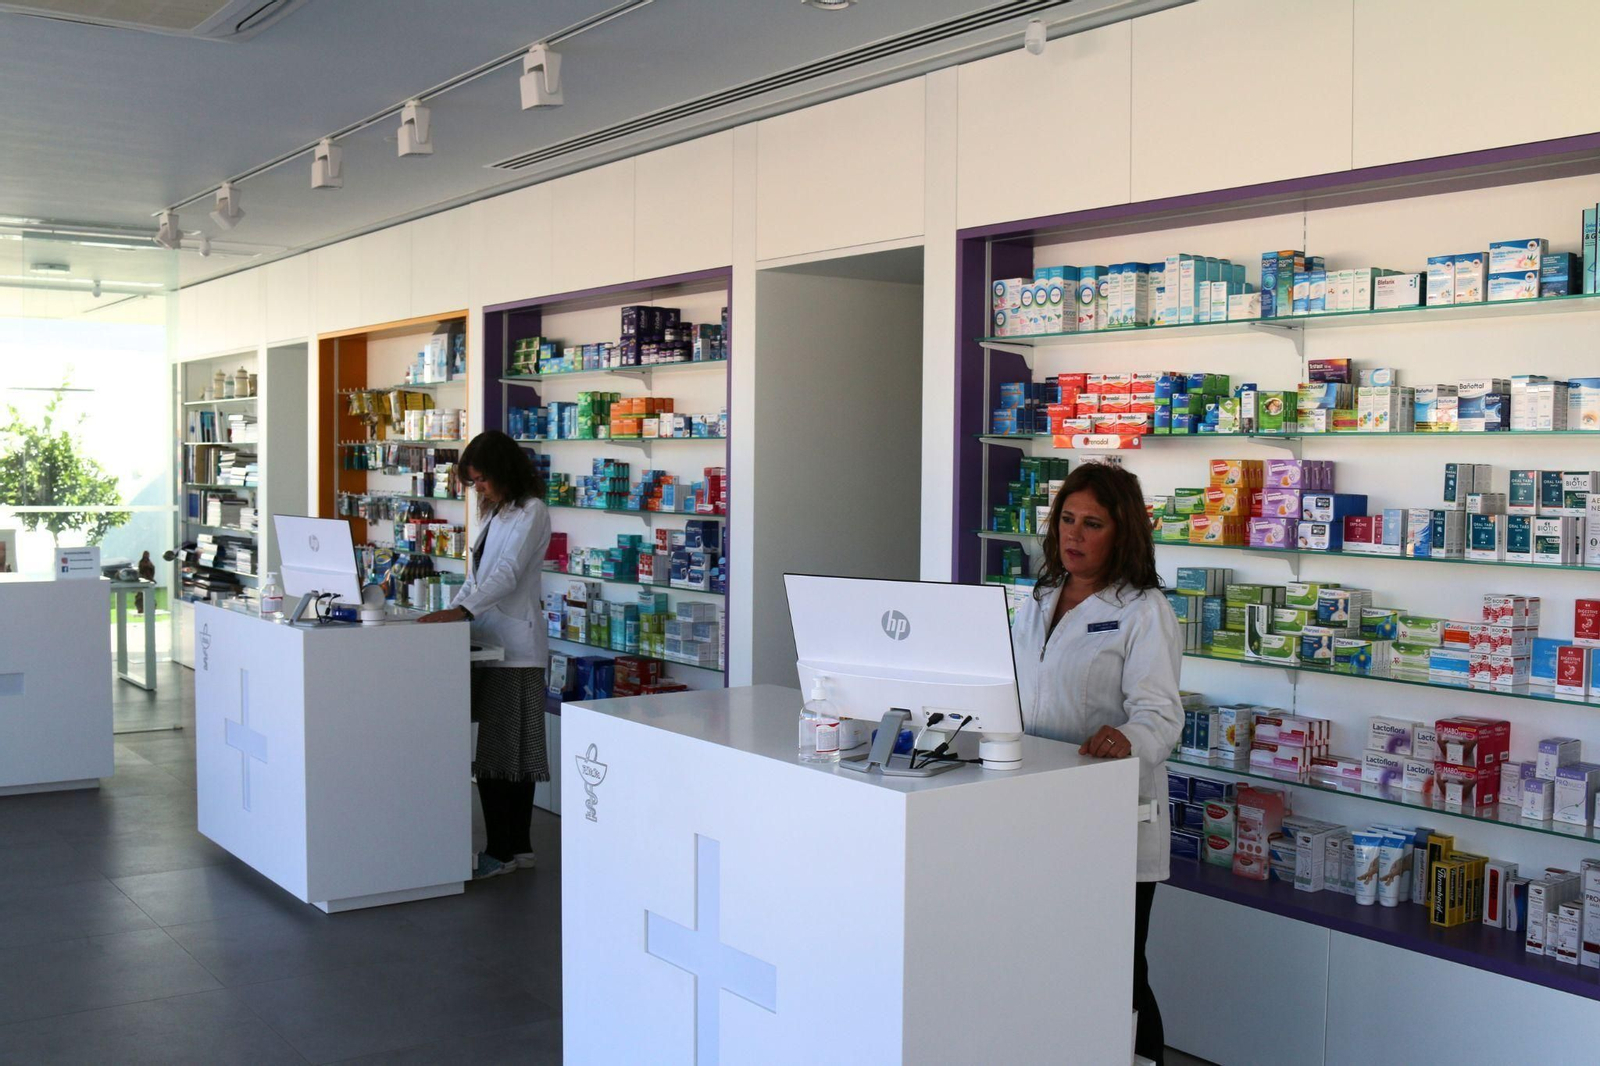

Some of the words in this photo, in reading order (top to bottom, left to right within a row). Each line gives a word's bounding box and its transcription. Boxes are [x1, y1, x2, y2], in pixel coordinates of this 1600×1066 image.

[1372, 723, 1406, 734] Lactoflora
[1366, 756, 1398, 767] Lactoflora
[1407, 764, 1435, 775] Lactoflo
[1436, 868, 1446, 913] Thrombocid
